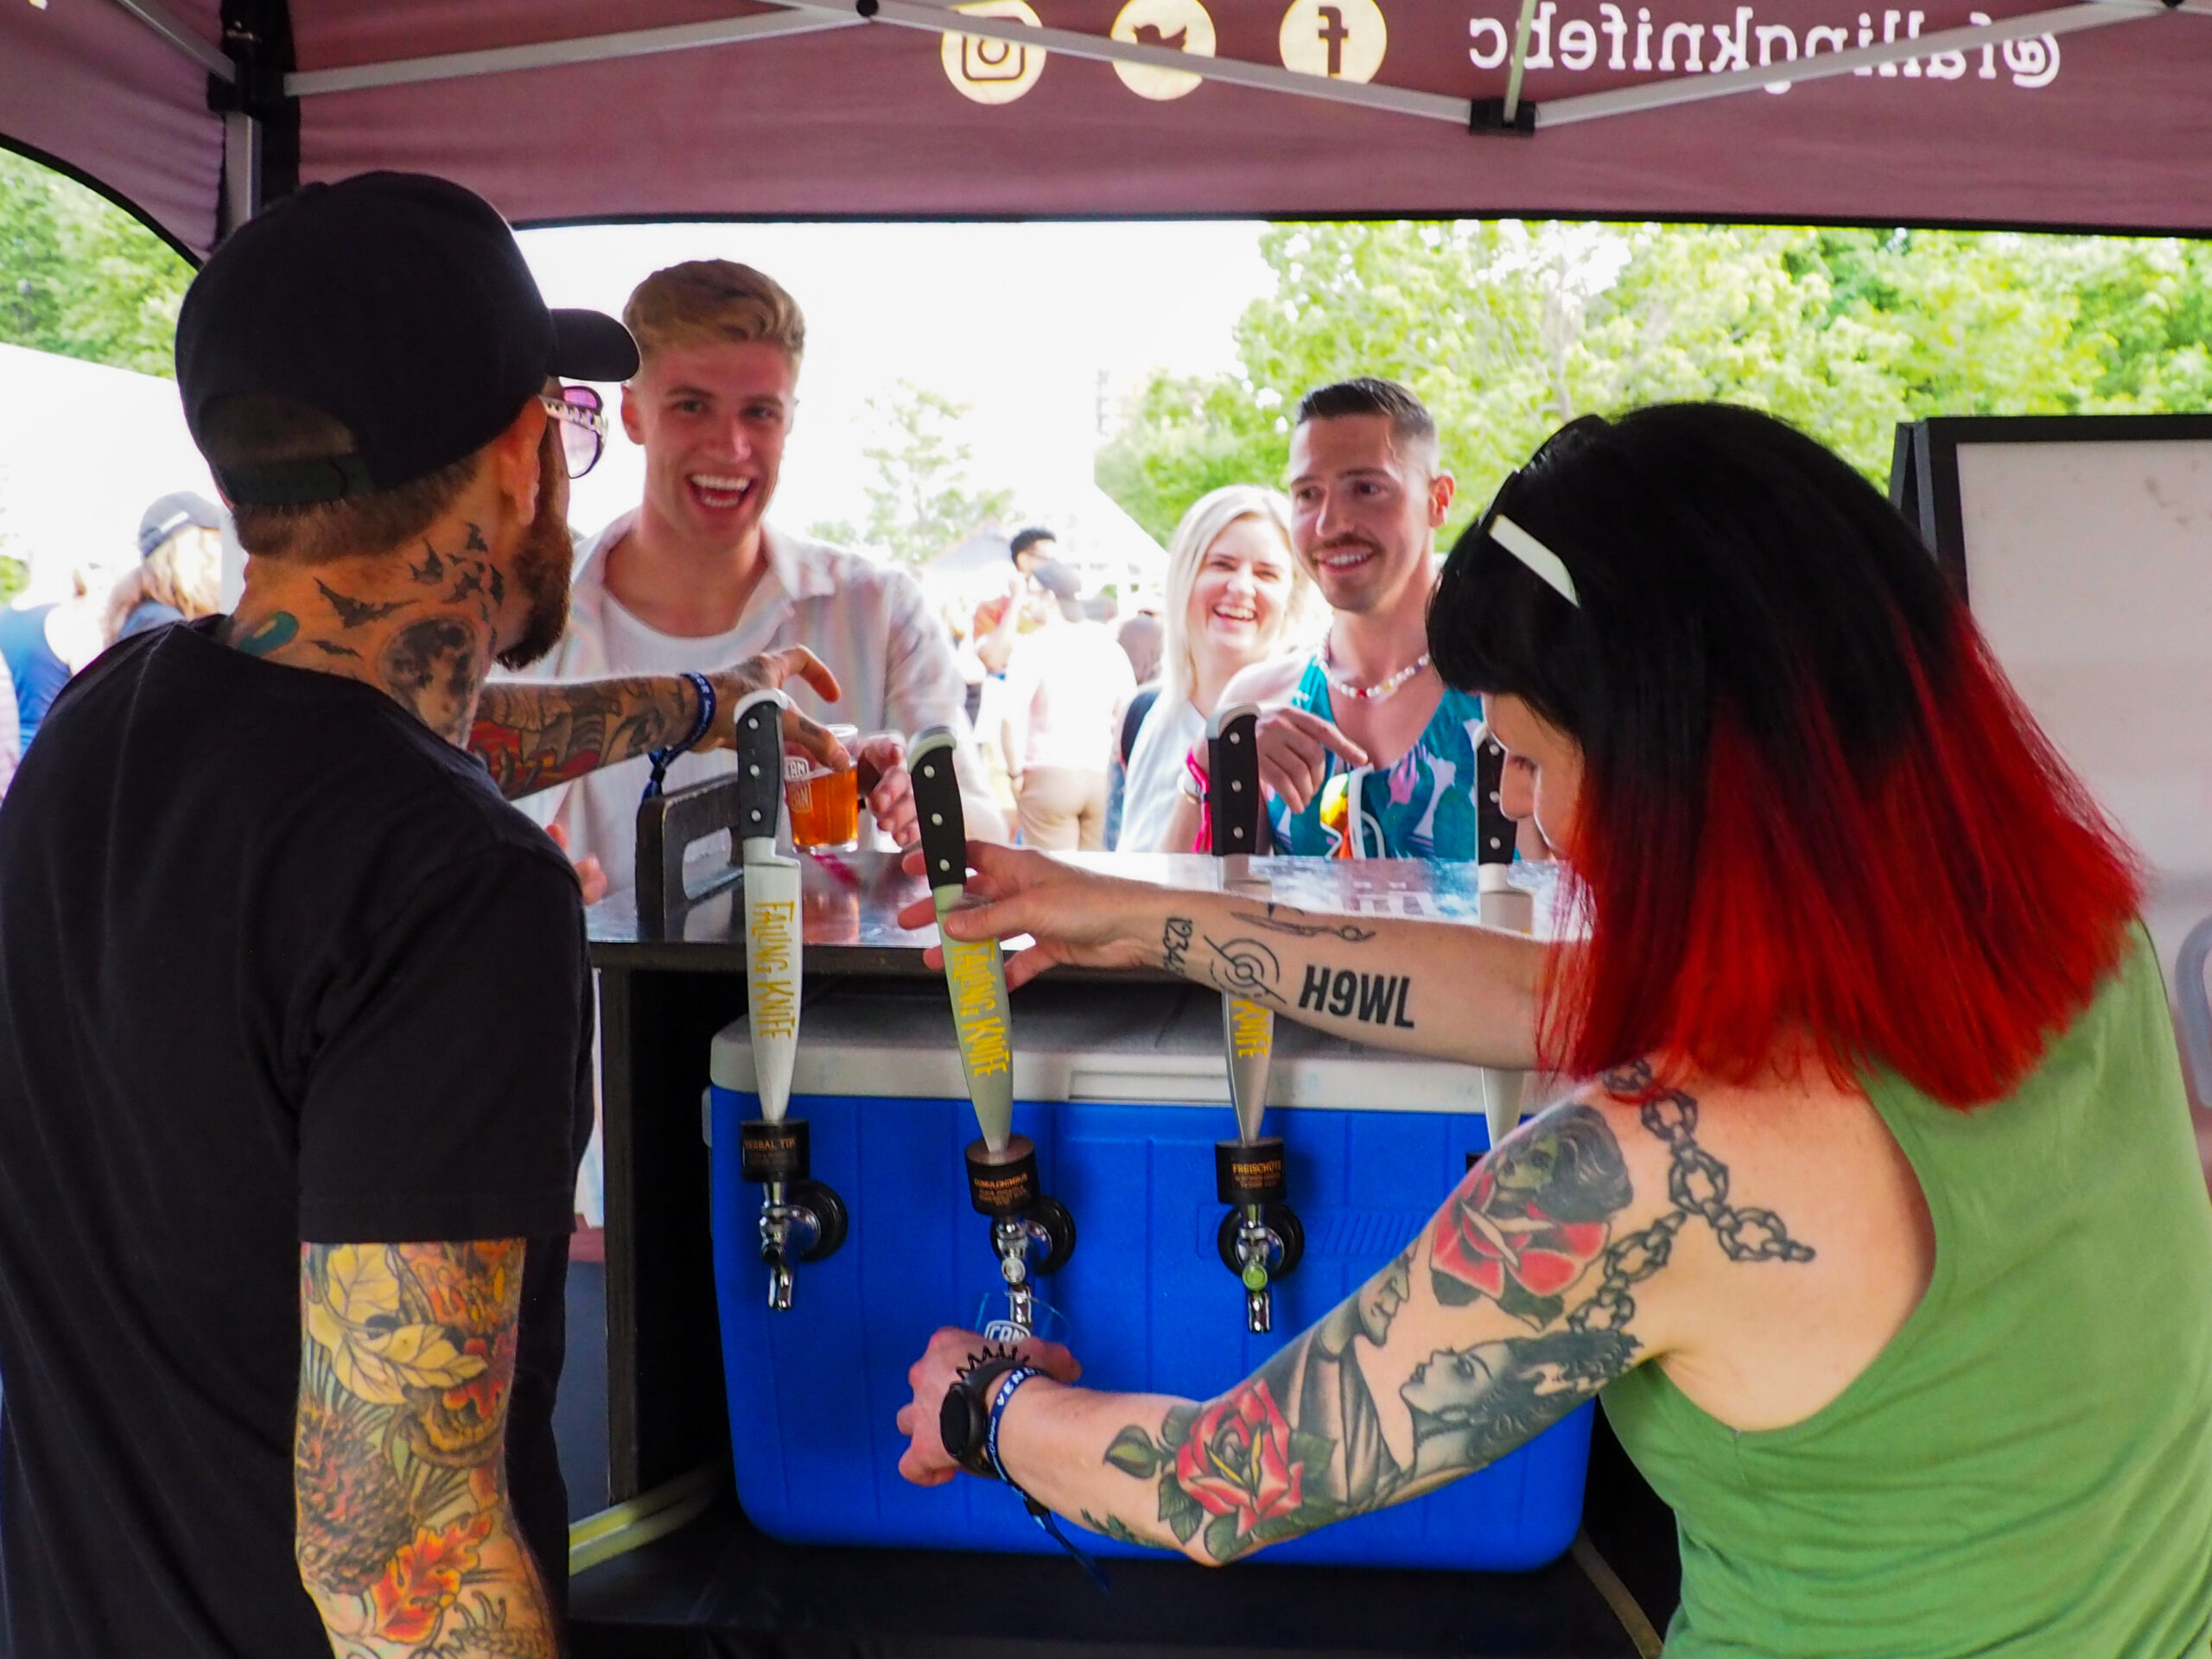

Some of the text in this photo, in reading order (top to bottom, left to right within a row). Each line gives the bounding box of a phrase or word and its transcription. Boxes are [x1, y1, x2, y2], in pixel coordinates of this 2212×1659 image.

[751, 901, 797, 1039] FALLING KNIFE
[951, 940, 1011, 1077] FALLING KNIFE
[1298, 963, 1415, 1029] H9WL
[1231, 999, 1273, 1059] KNIFE
